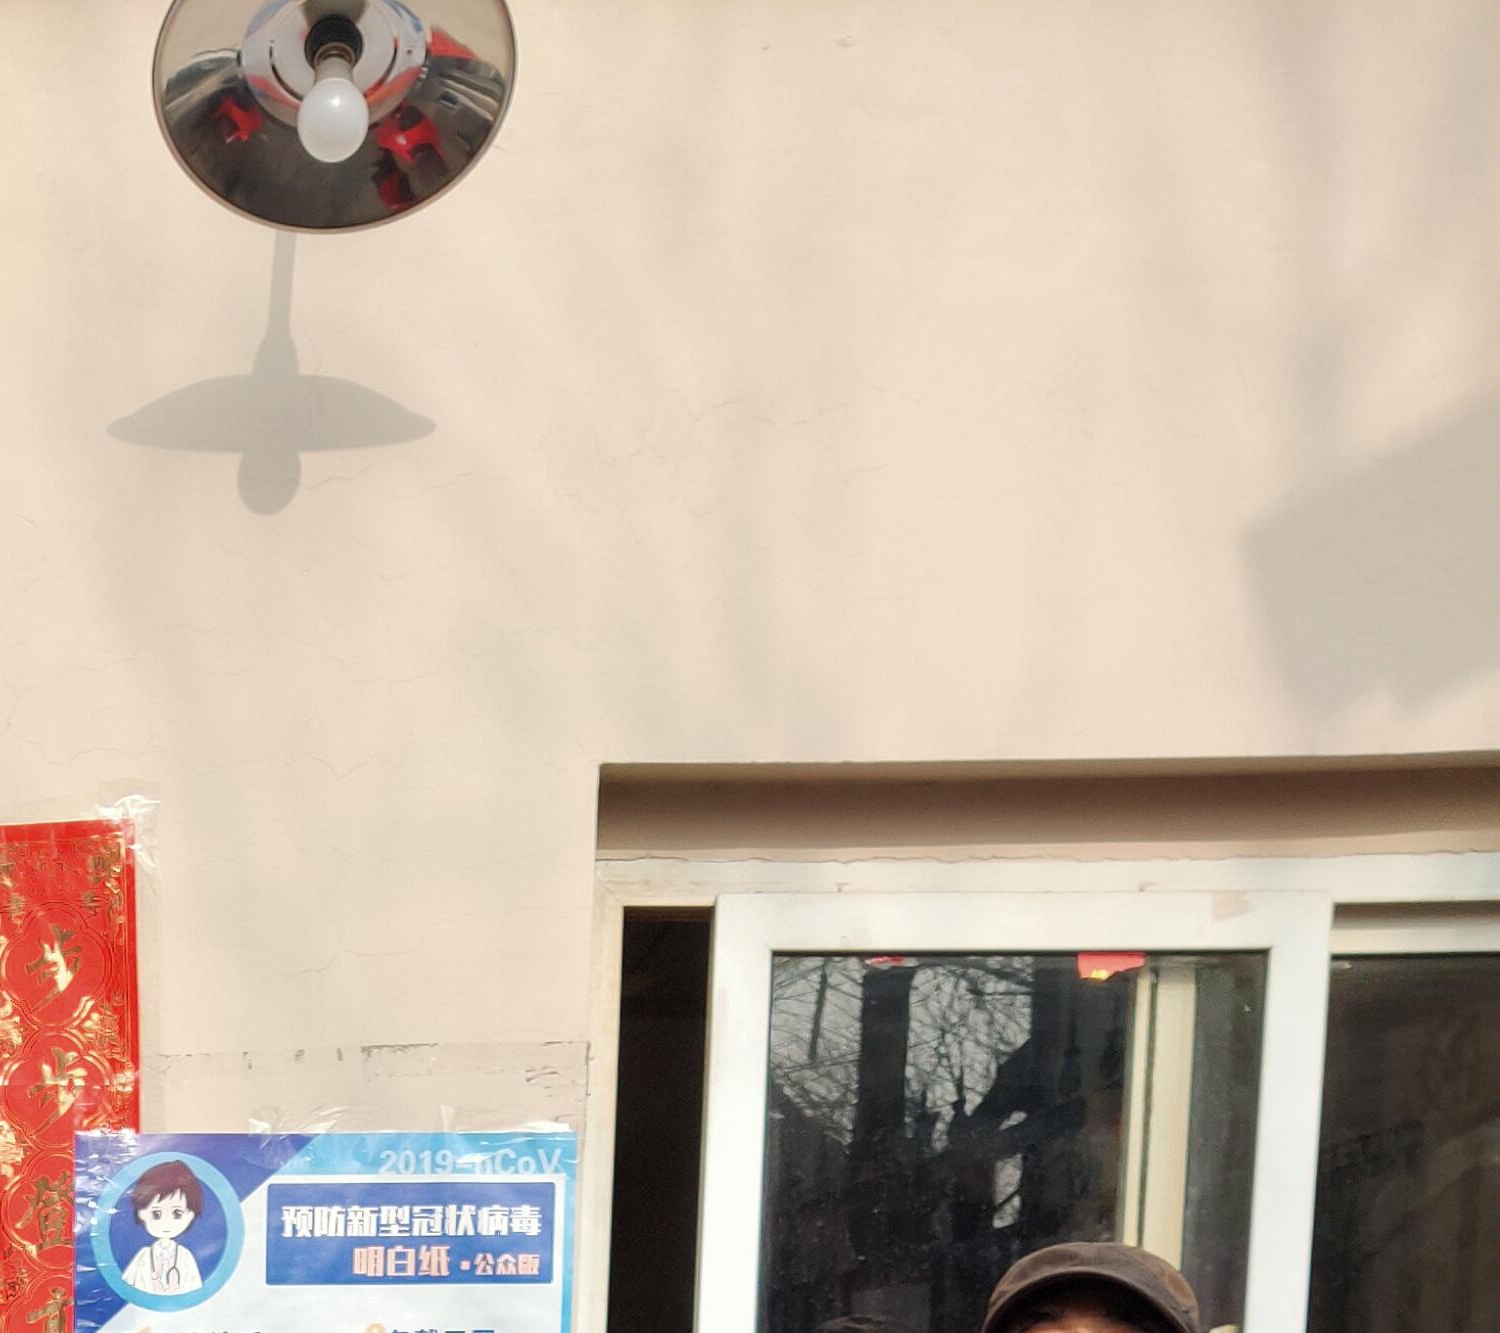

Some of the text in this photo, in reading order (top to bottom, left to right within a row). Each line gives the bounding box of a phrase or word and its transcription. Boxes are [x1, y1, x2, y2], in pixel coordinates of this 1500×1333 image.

[281, 1205, 543, 1238] 预防新型冠状病毒
